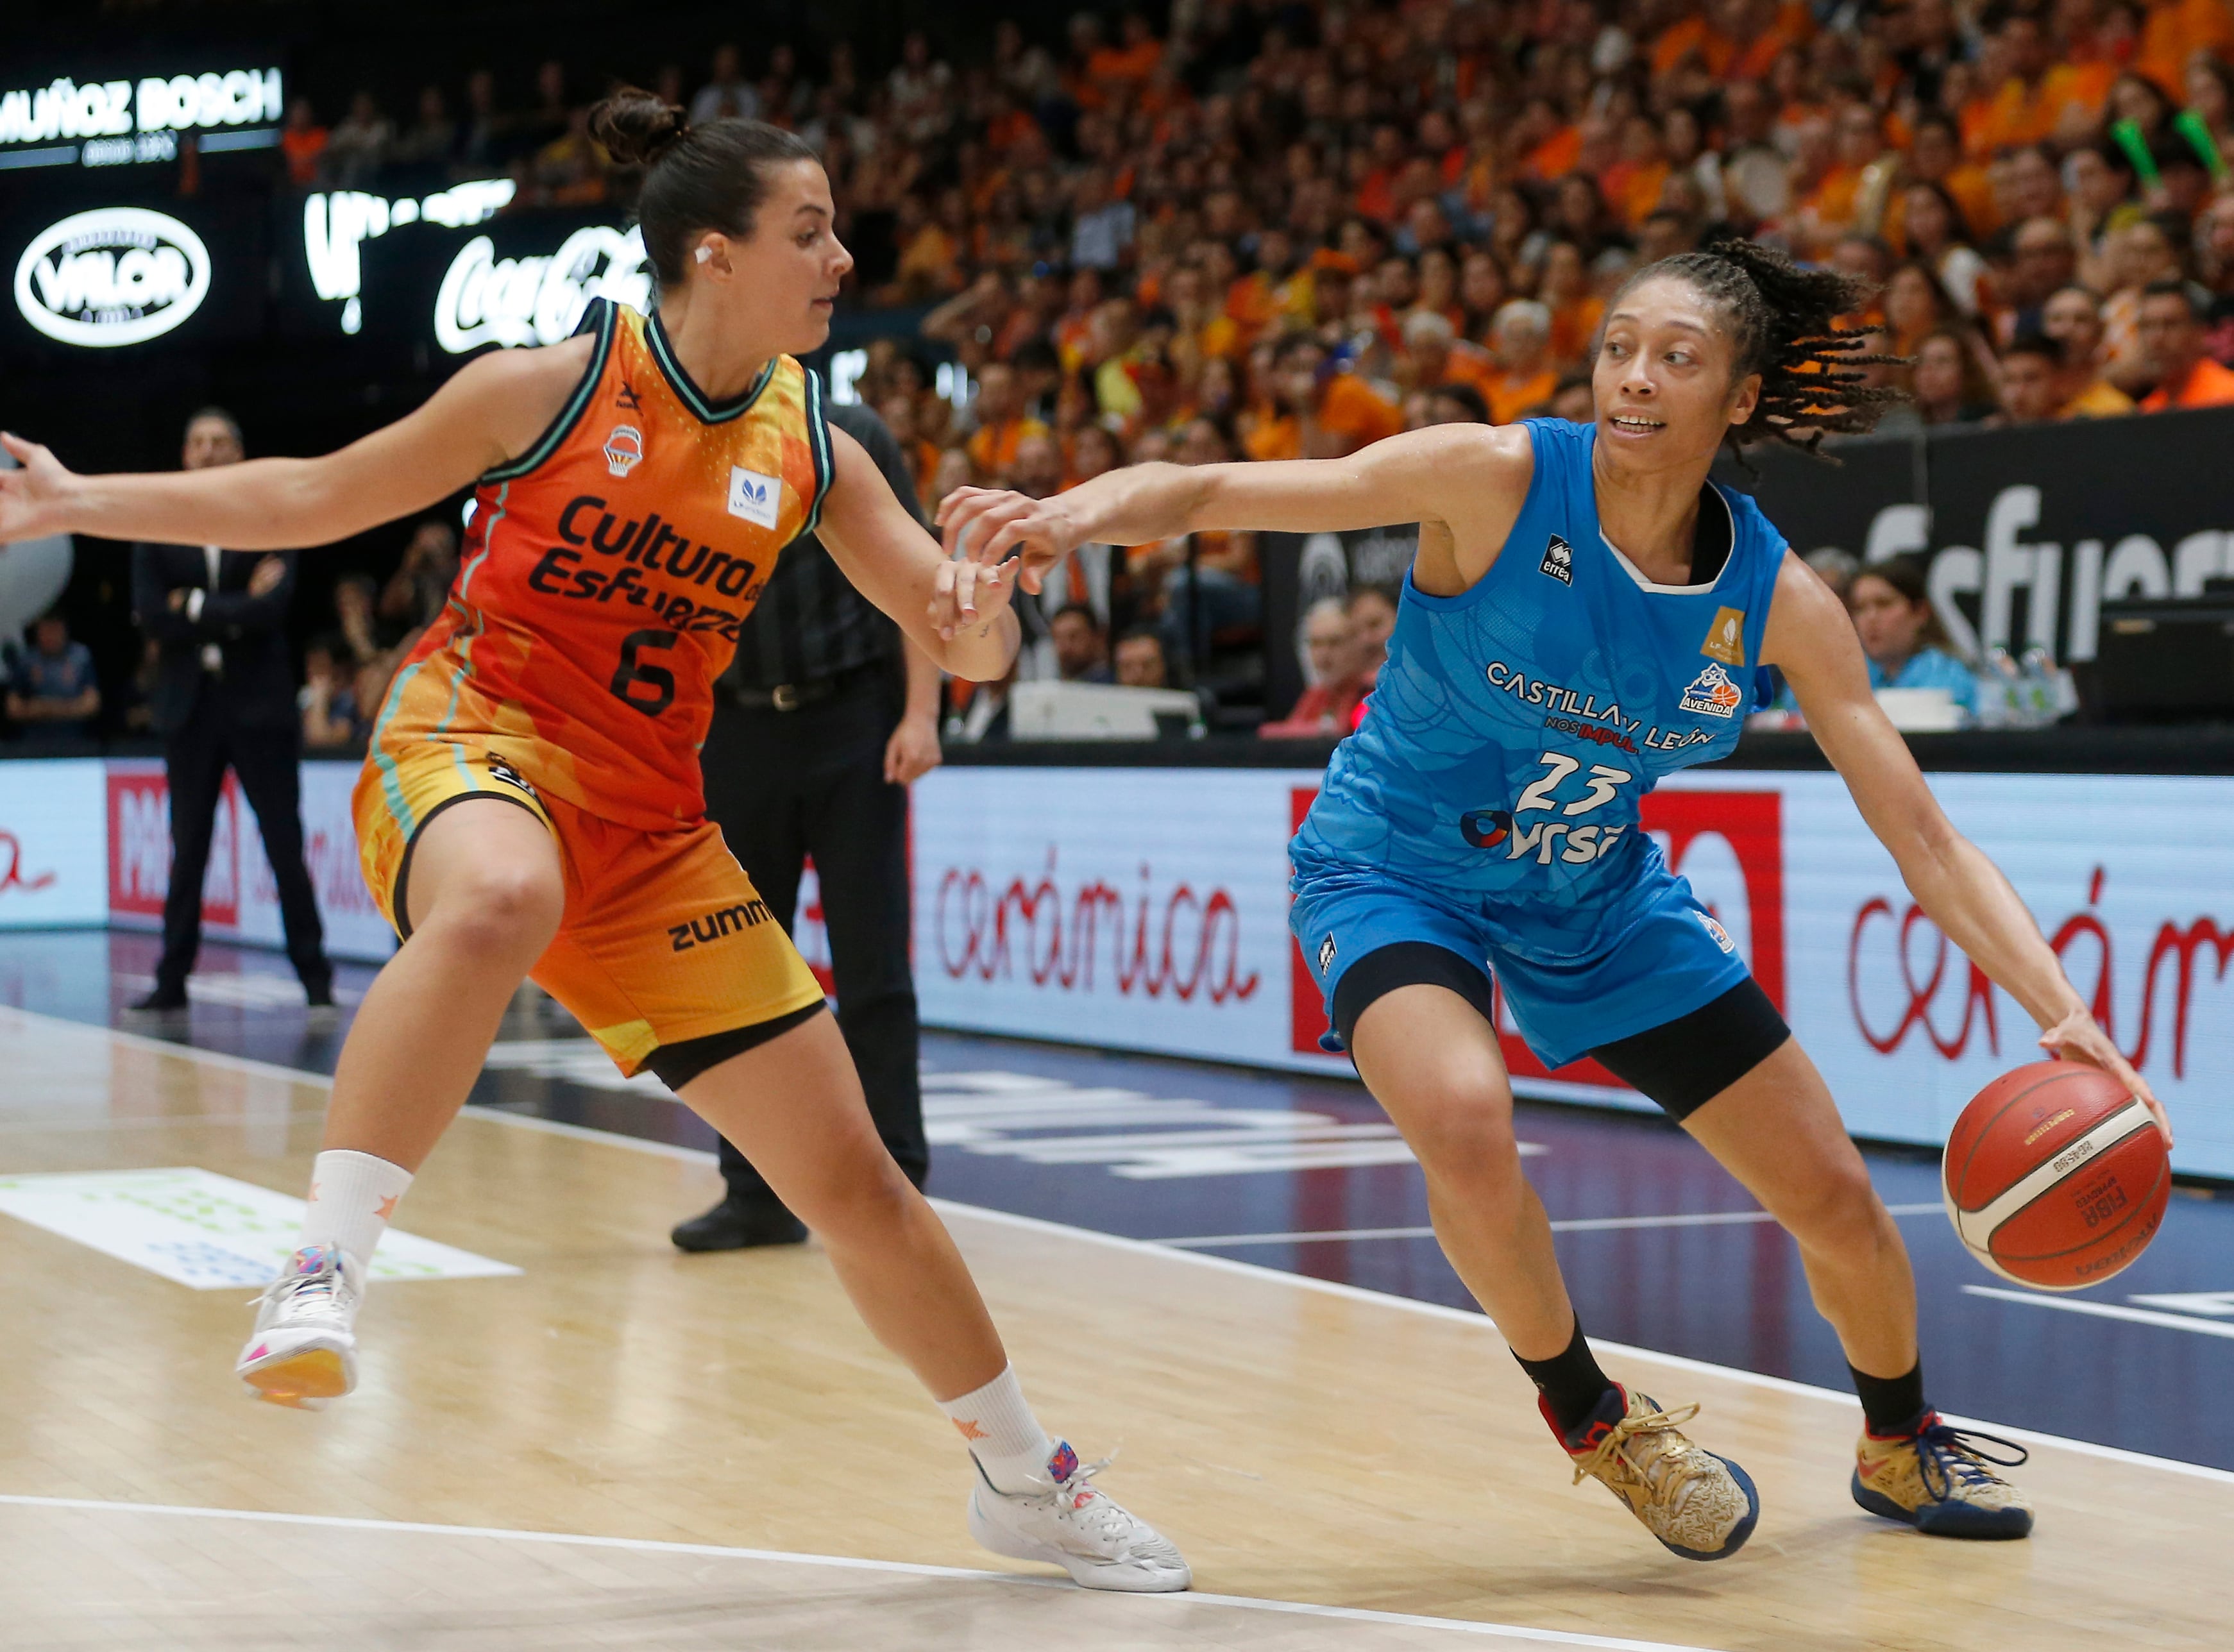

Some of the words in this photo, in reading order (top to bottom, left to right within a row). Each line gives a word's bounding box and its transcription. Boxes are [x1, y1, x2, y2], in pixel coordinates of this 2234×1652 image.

[136, 67, 283, 133] BOSCH
[557, 495, 757, 597] Cultura
[610, 628, 679, 717] 6
[1486, 661, 1621, 729] CASTILLA
[1643, 726, 1717, 751] LEÓN
[1682, 696, 1733, 716] AVENIDA
[1515, 752, 1632, 816] 23
[933, 841, 1262, 1006] cerámica
[2083, 1185, 2129, 1228] FIBA
